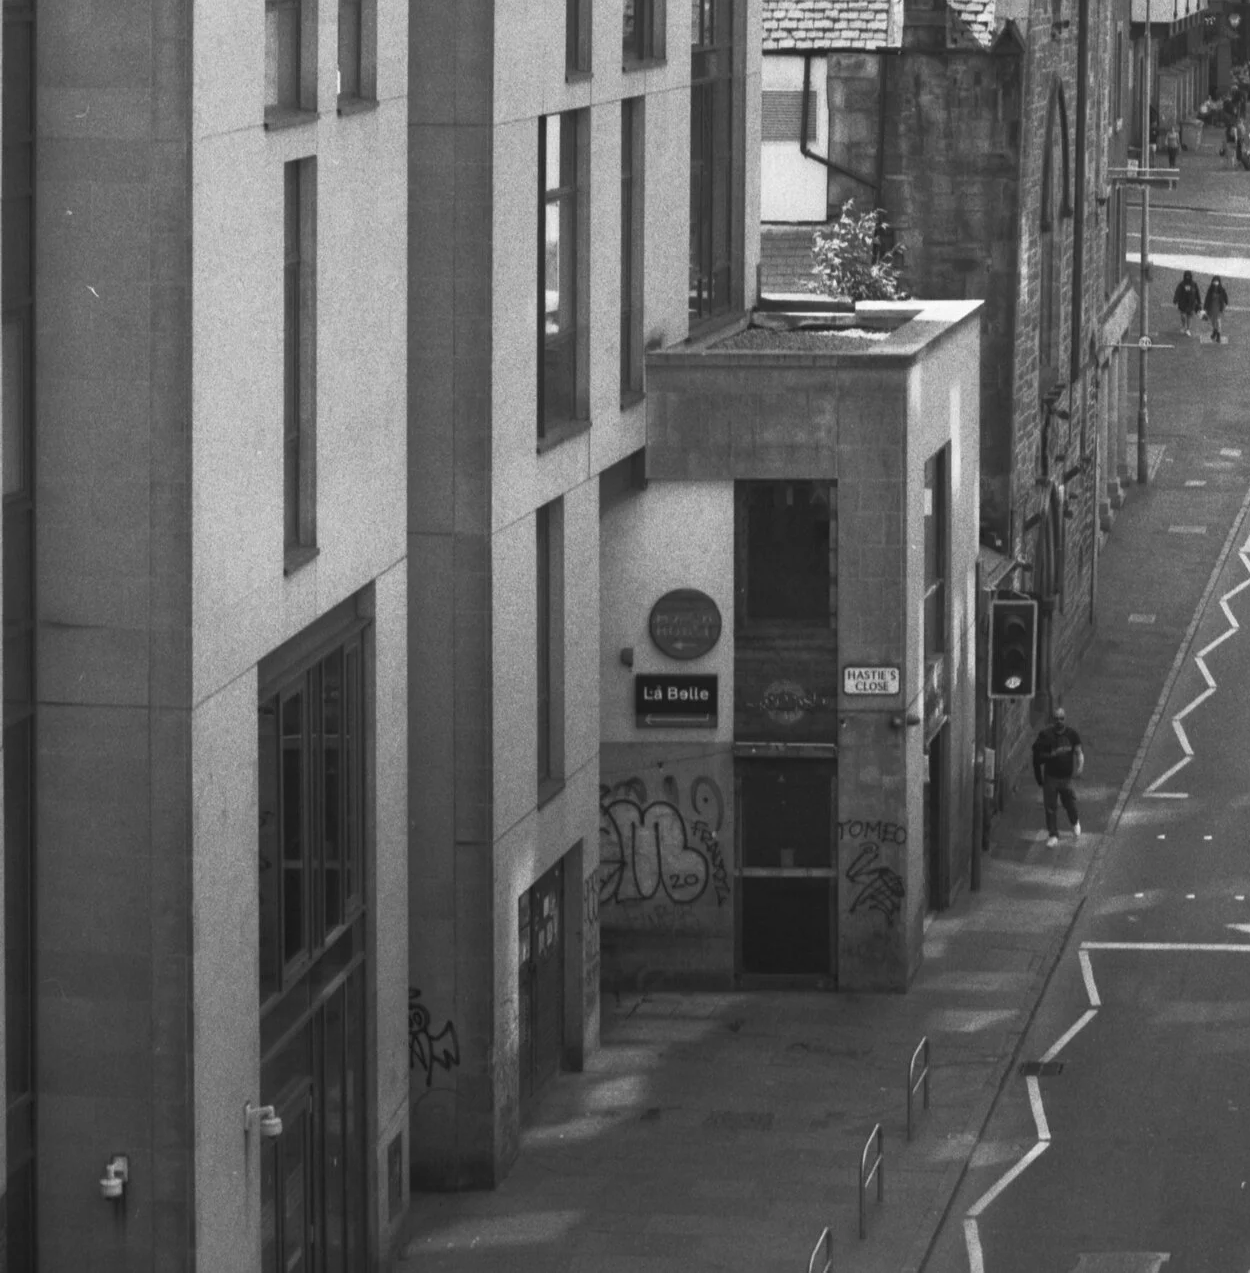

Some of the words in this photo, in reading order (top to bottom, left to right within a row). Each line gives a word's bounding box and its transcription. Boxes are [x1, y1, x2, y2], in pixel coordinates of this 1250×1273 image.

[847, 670, 896, 680] HASTIE'S
[855, 682, 888, 691] CLOSE
[667, 686, 709, 700] Belle
